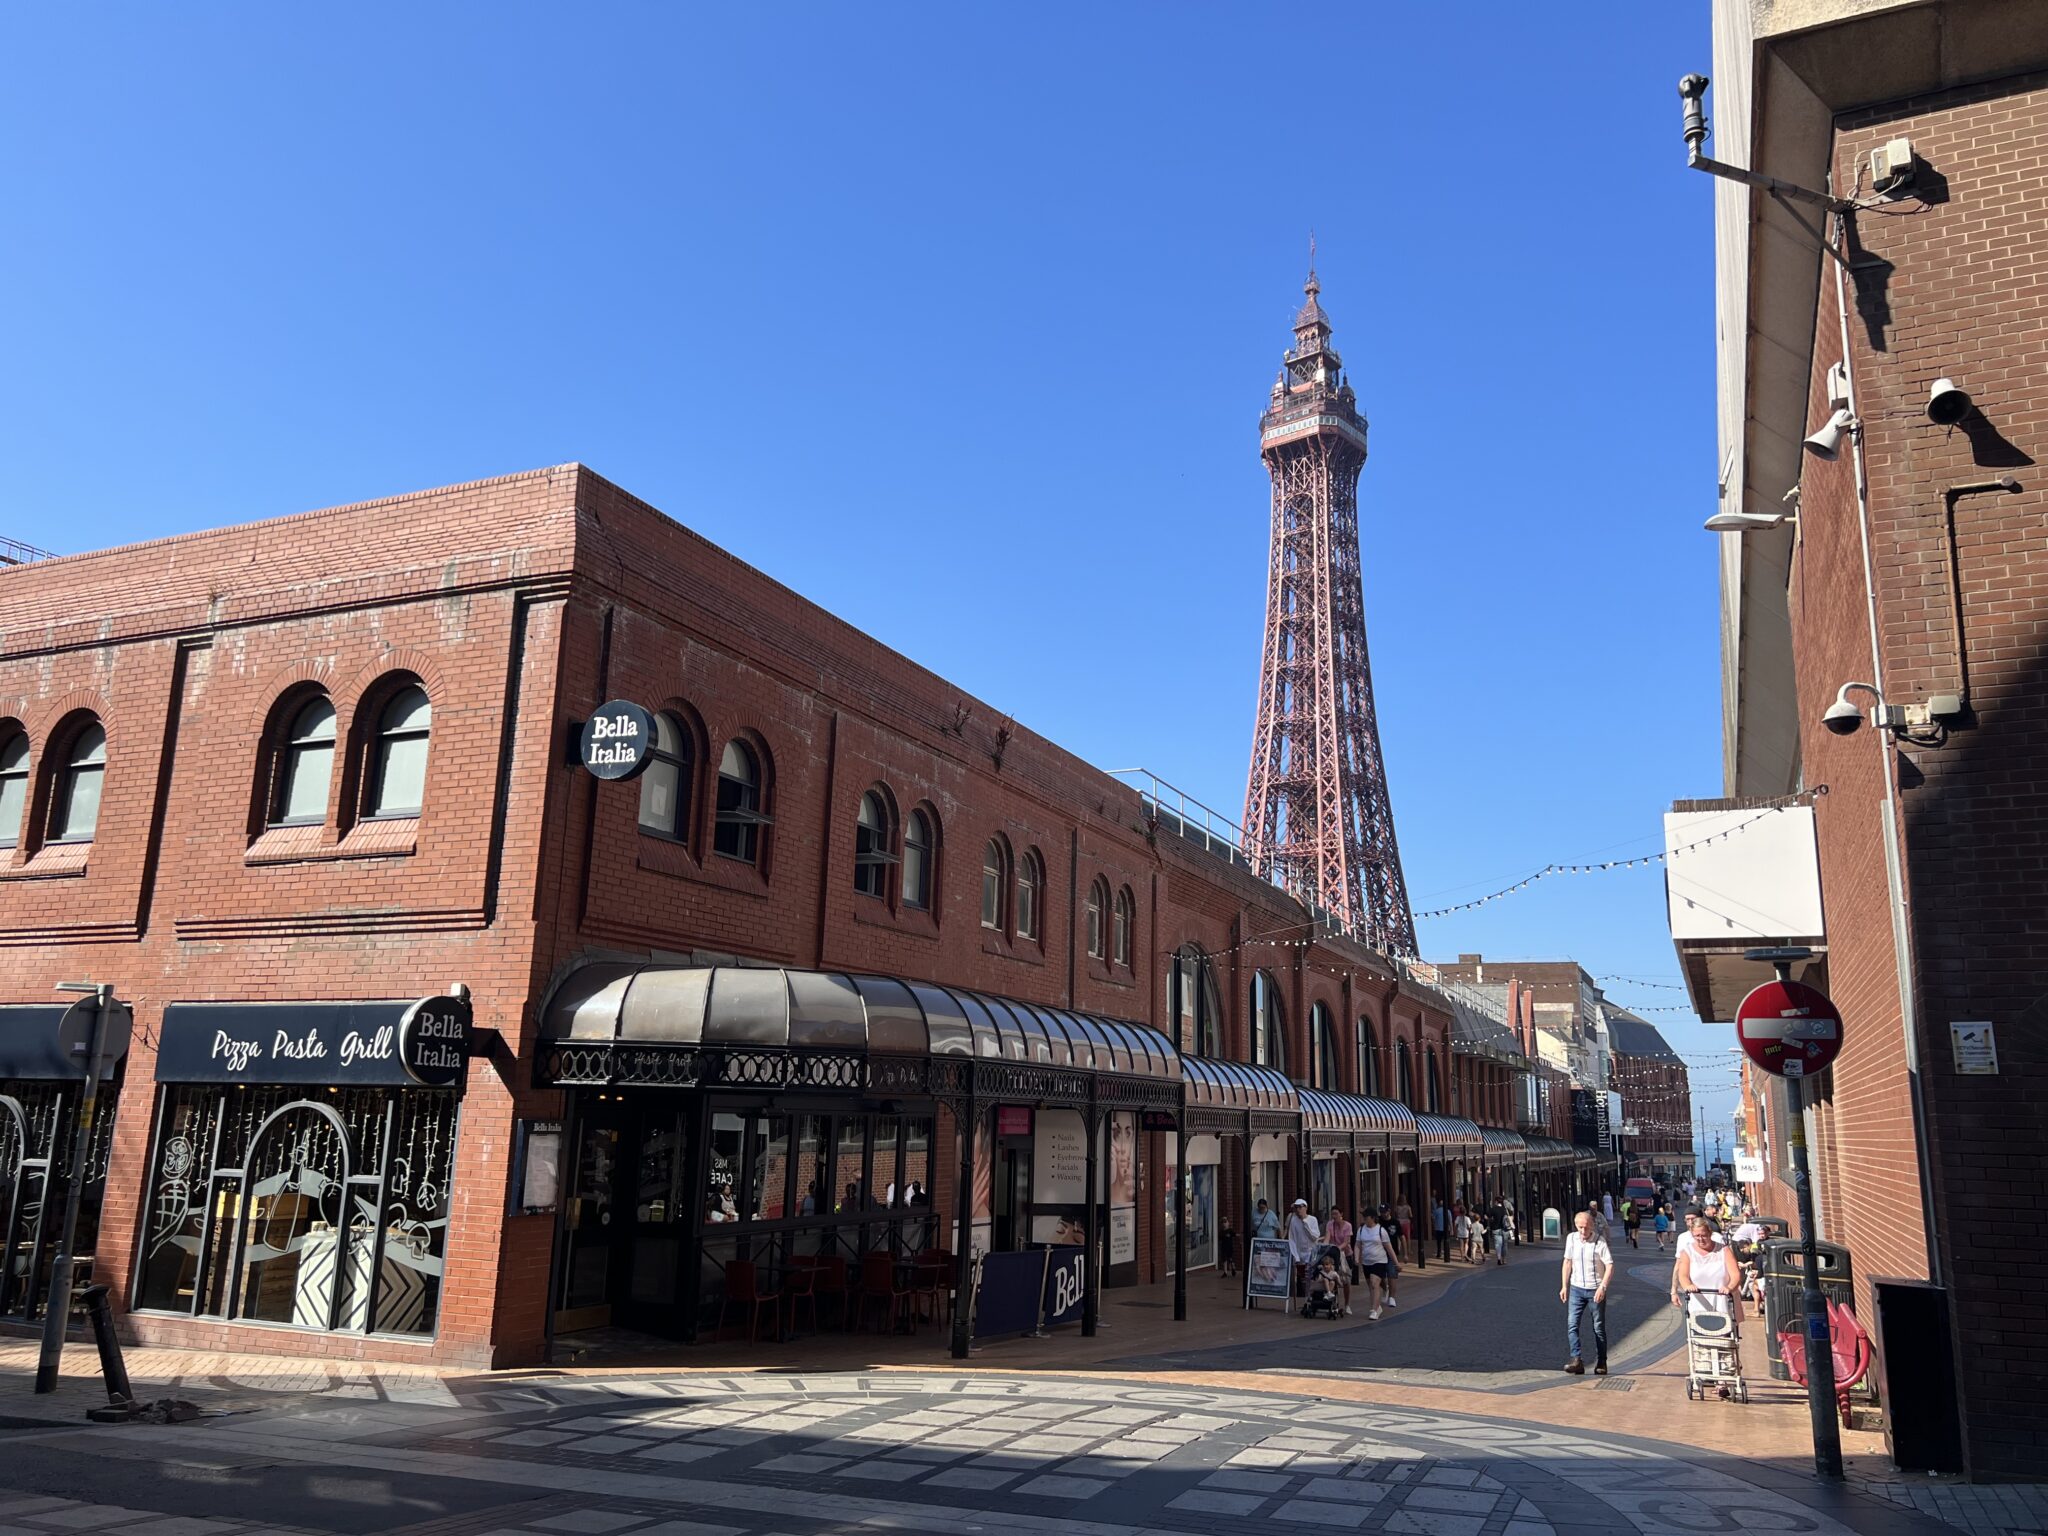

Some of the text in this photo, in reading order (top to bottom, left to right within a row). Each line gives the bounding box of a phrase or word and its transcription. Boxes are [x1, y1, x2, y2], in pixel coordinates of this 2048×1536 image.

[591, 714, 639, 739] Bella
[587, 741, 637, 764] Italia
[418, 1012, 464, 1039] Bella
[211, 1025, 394, 1071] Pizza Pasta Grill
[414, 1042, 462, 1068] Italia
[1057, 1134, 1075, 1142] Nails
[1056, 1174, 1082, 1183] Waxing
[1741, 1164, 1758, 1172] M&S
[1053, 1254, 1084, 1317] Bell
[473, 1377, 1027, 1412] WINTER
[1114, 1390, 1819, 1533] GARDENS
